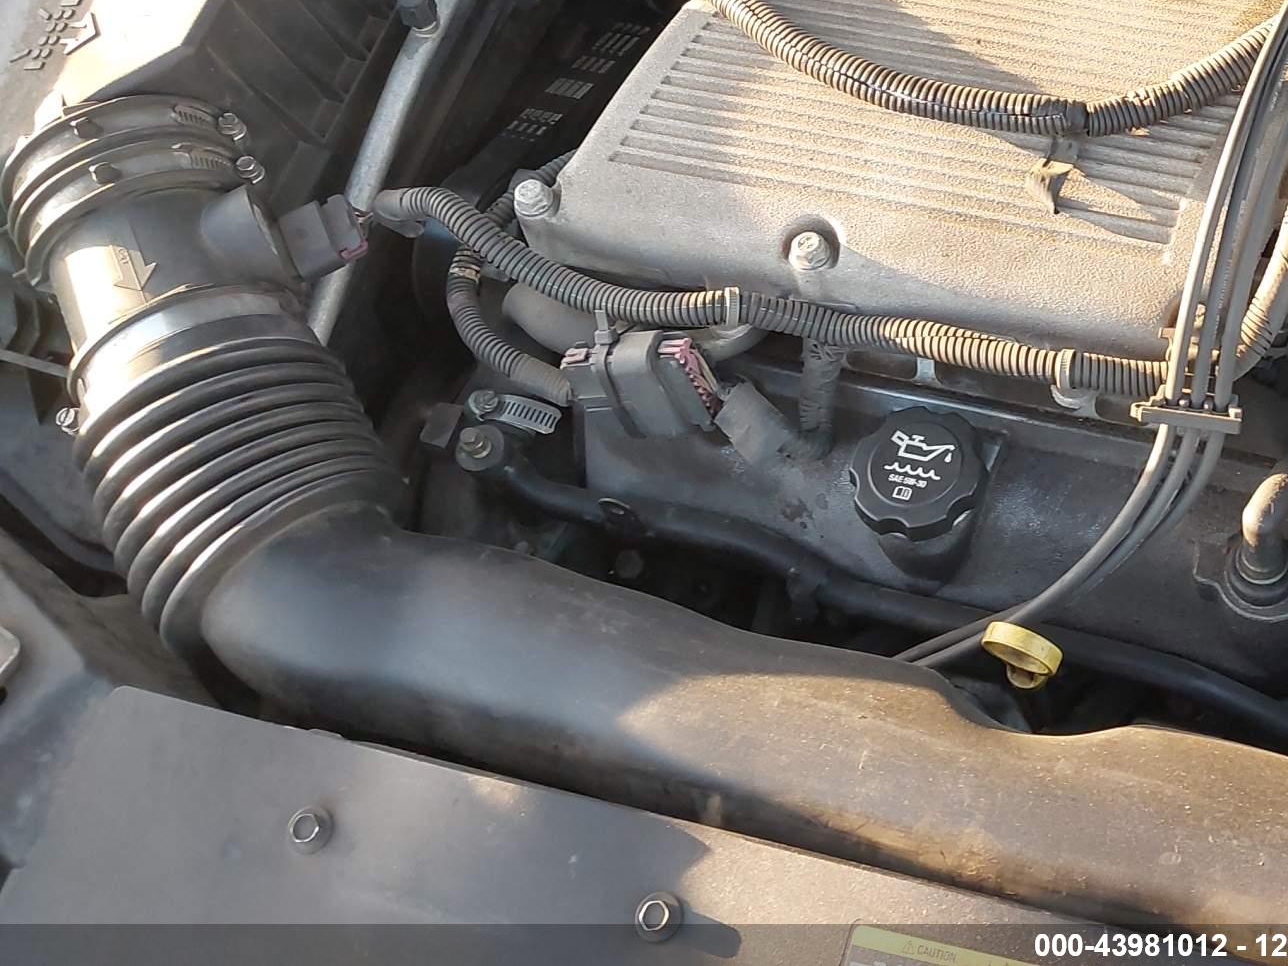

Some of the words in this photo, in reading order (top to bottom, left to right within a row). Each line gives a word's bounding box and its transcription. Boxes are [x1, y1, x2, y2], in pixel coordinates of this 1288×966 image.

[888, 474, 904, 484] SAE
[903, 476, 928, 488] 5W-30
[916, 944, 957, 963] CAUTION
